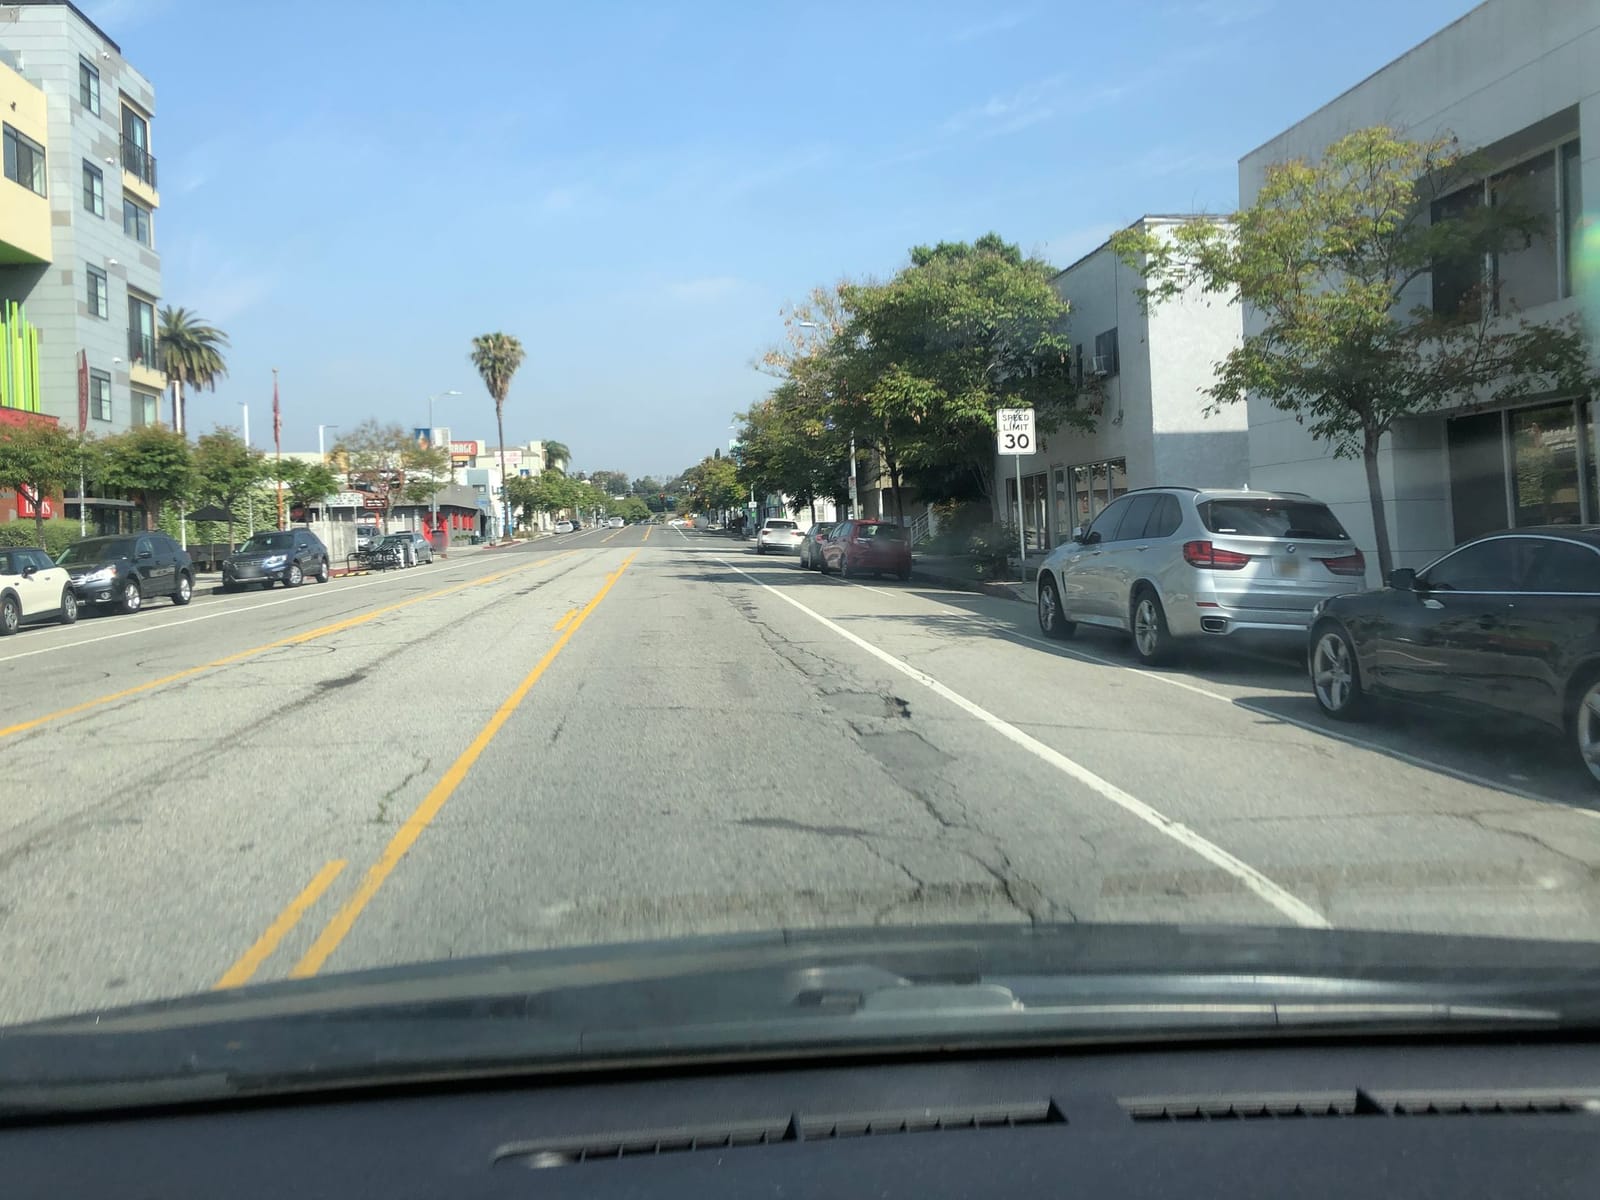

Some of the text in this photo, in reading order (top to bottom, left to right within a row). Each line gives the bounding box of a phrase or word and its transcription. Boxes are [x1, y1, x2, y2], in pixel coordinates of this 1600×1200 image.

[1002, 414, 1030, 422] SPEED
[1003, 423, 1029, 431] LIMIT
[1004, 433, 1030, 449] 30
